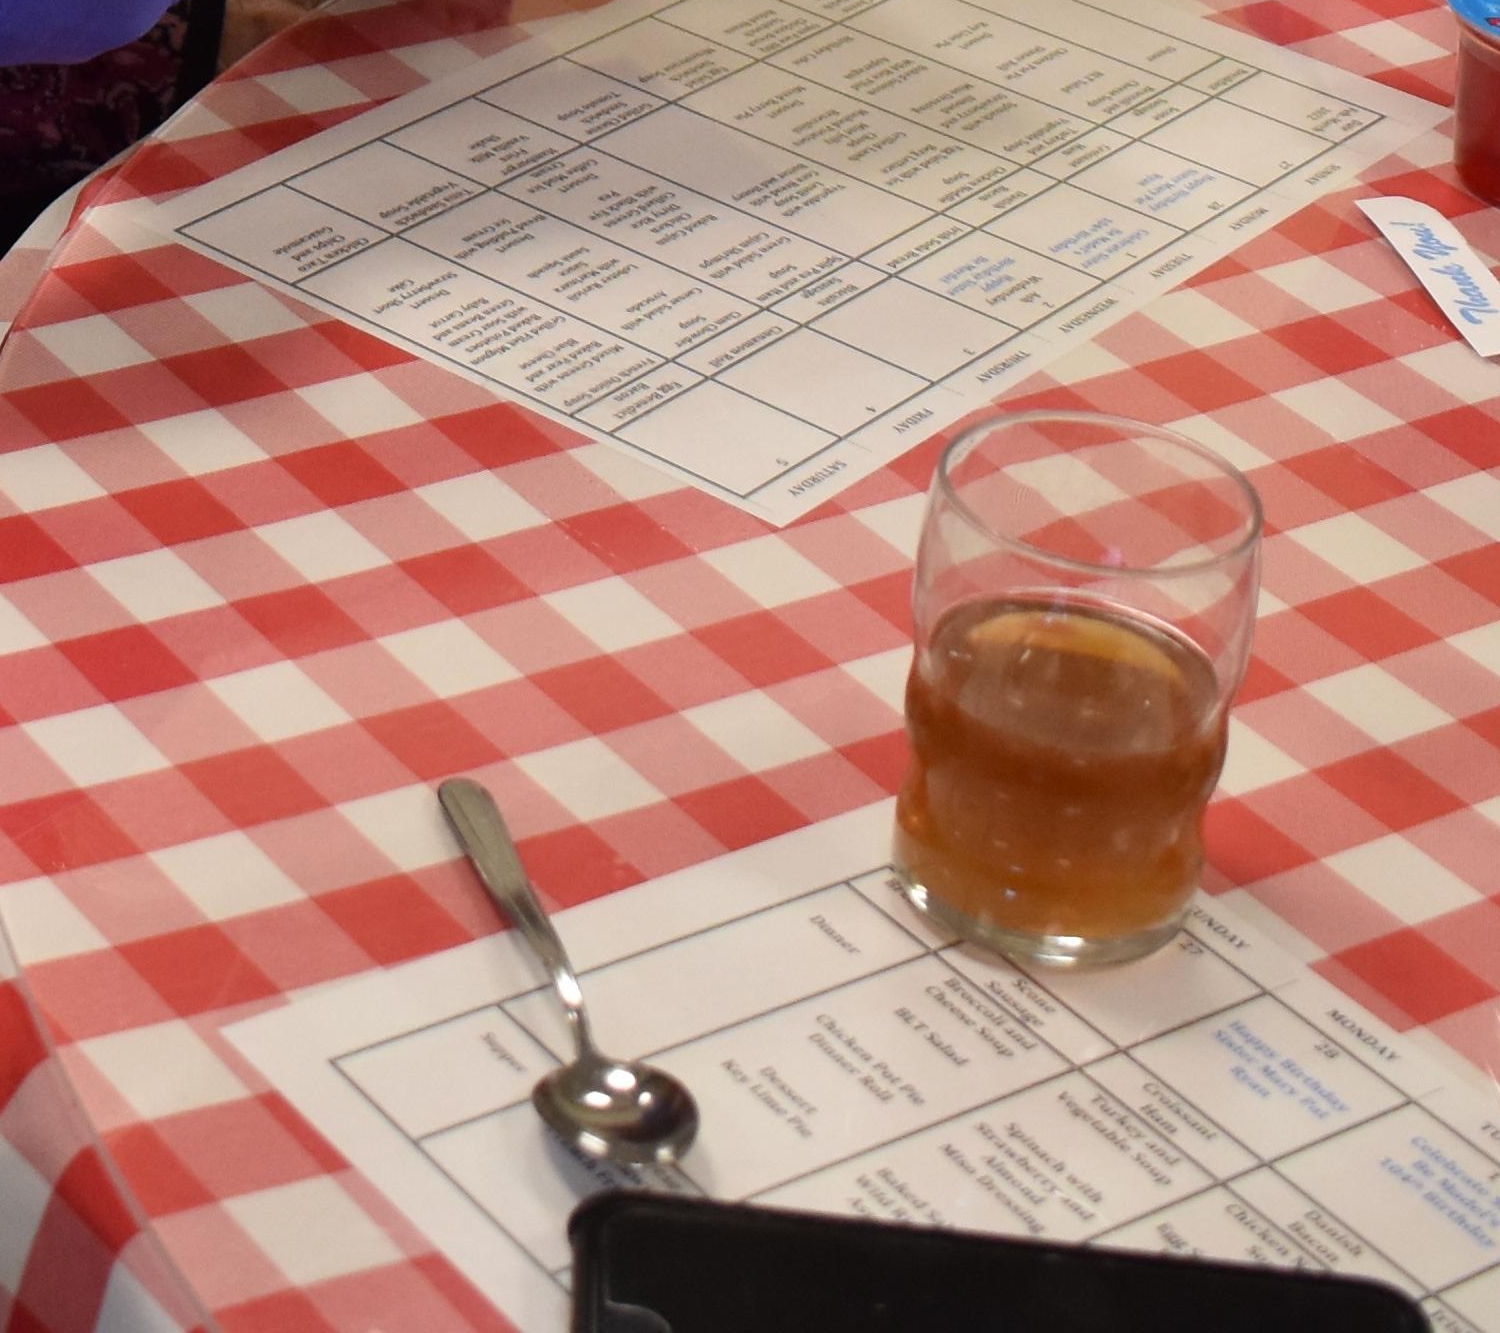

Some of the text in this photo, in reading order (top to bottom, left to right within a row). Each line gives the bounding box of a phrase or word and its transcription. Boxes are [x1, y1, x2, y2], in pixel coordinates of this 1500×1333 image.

[1205, 200, 1225, 211] 28
[1227, 206, 1270, 231] MONDAY
[707, 234, 792, 279] Green Salad with
[884, 224, 965, 269] Irish Soda Bread
[1147, 252, 1194, 279] TUESDAY
[799, 275, 844, 299] Sausage
[815, 282, 860, 307] Biscuits
[983, 274, 1044, 307] Wednesday
[1389, 221, 1500, 326] Thank You!
[408, 287, 452, 310] Dessert
[427, 296, 490, 329] Baby Carrot
[430, 297, 516, 342] Green Beans and
[1040, 300, 1056, 309] 2
[1057, 296, 1119, 334] WEDNESDAY
[446, 305, 529, 348] with Sour Cream
[463, 312, 543, 354] Baked Potatoes
[468, 314, 567, 366] Grilled Filet Mignon
[673, 310, 743, 348] Clam Chowder
[677, 314, 708, 330] Soup
[517, 336, 580, 371] Blue Cheese
[523, 339, 604, 383] Baked Pear and
[532, 343, 625, 393] Mixed Greens with
[706, 324, 784, 369] Cinnamon Roll
[961, 347, 977, 356] 3
[974, 349, 1032, 384] THURSDAY
[562, 356, 656, 408] French Onion Soup
[611, 381, 651, 402] Bacon
[611, 380, 684, 420] Egg Benedict
[864, 405, 877, 413] 4
[891, 406, 935, 434] FRIDAY
[774, 457, 790, 467] 5
[786, 459, 848, 497] SATURDAY
[807, 913, 861, 954] Dinner
[942, 976, 1039, 1052] Broccoli and
[984, 979, 1045, 1027] Sausage
[1011, 977, 1057, 1014] Scone
[892, 1006, 970, 1067] BLT Salad
[923, 984, 1015, 1059] Cheese Soup
[1325, 1008, 1398, 1062] MONDAY
[806, 1031, 894, 1104] Dinner Roll
[814, 1013, 926, 1107] Chicken Pot Pie
[1227, 1019, 1350, 1113] Happy Birthday
[1312, 1039, 1342, 1060] 28
[758, 1065, 818, 1116] Dessert
[1211, 1028, 1331, 1121] Sister Mary Pat
[1228, 1064, 1271, 1099] Ryan
[720, 1058, 813, 1139] Key Lime Pie
[1138, 1102, 1178, 1135] Ham
[1141, 1081, 1218, 1141] Croissant
[1056, 1090, 1173, 1187] Vegetable Soup
[1089, 1091, 1185, 1168] Turkey and
[972, 1121, 1060, 1194] Strawberry
[1003, 1121, 1104, 1205] Spinach with
[1409, 1135, 1490, 1197] Celebrate
[854, 1173, 896, 1208] Wild
[939, 1142, 1046, 1234] Miso Dressing
[981, 1154, 1047, 1207] Almond
[1155, 1221, 1187, 1249] Egg
[1224, 1203, 1290, 1257] Chicken
[1286, 1219, 1340, 1263] Bacon
[1302, 1207, 1364, 1258] Danish
